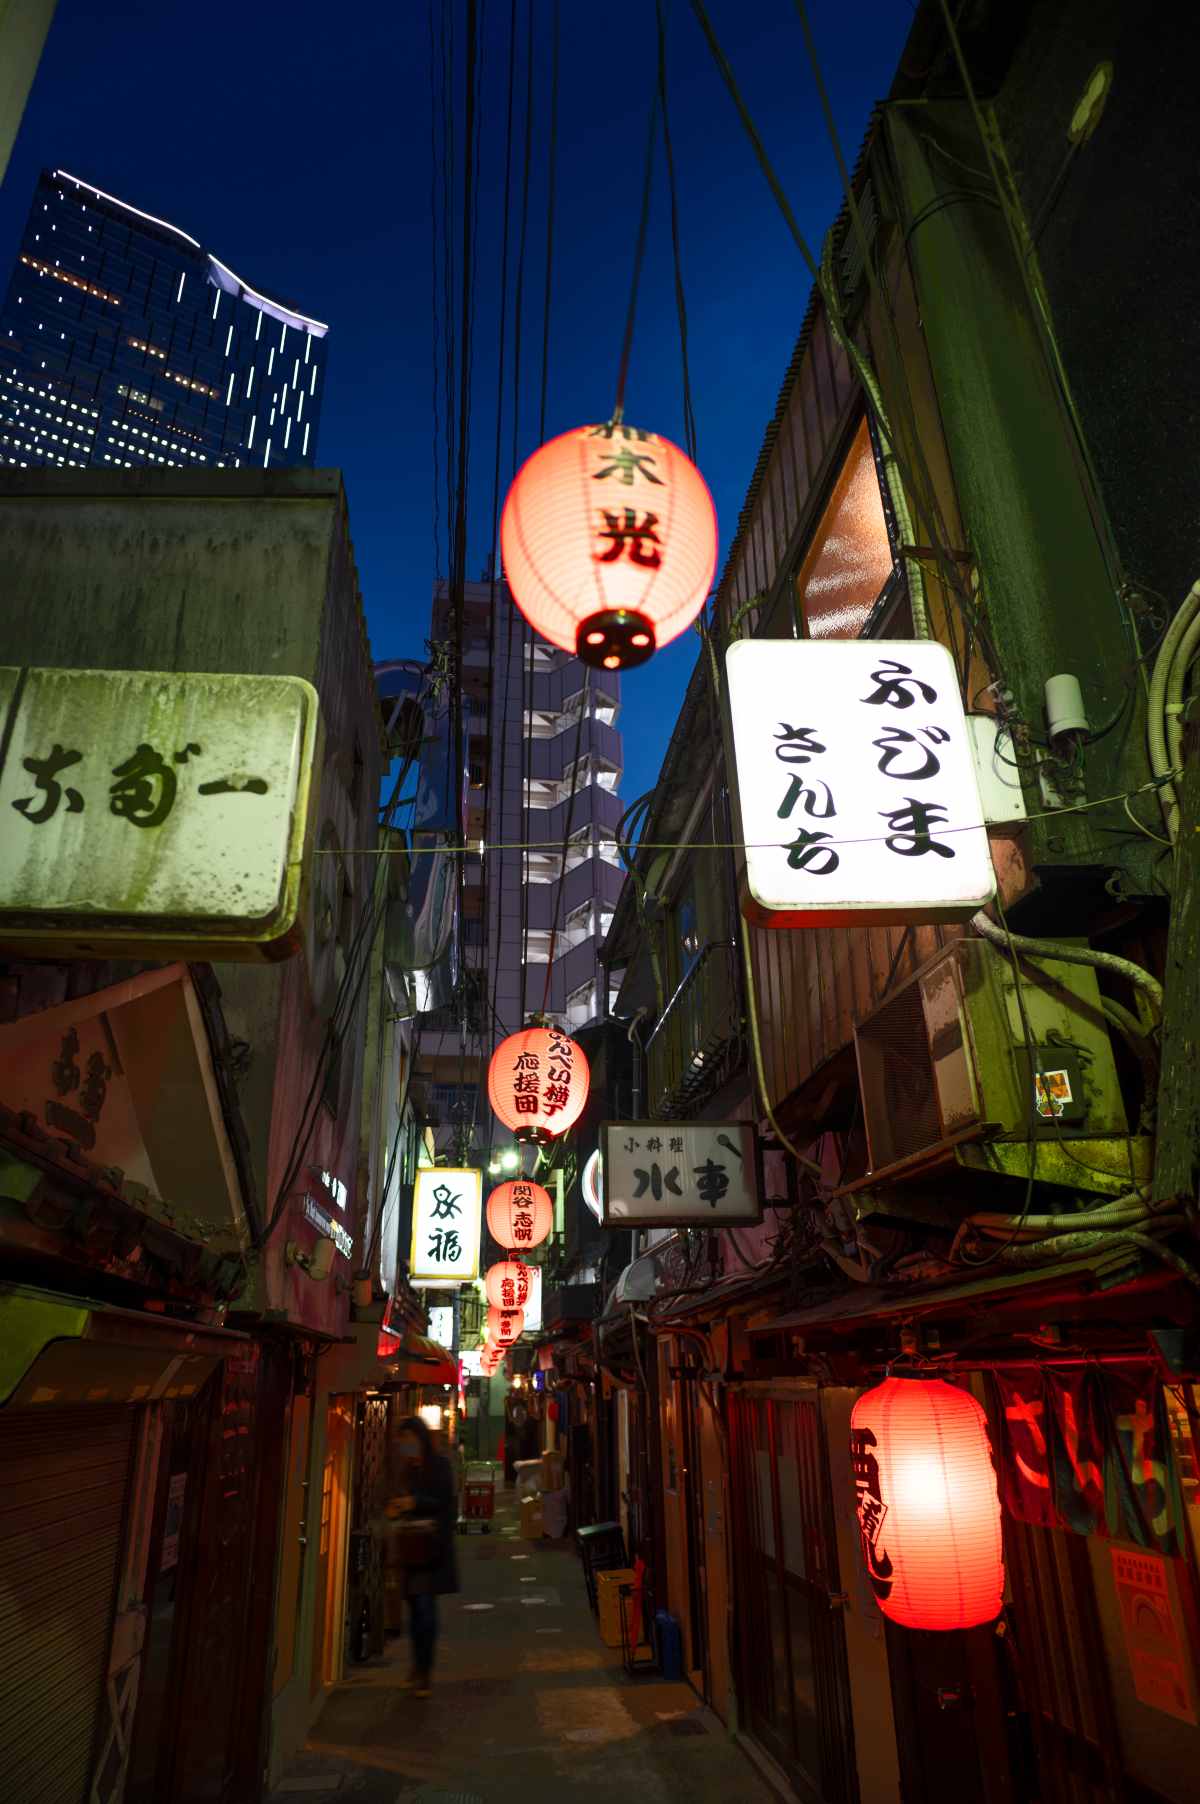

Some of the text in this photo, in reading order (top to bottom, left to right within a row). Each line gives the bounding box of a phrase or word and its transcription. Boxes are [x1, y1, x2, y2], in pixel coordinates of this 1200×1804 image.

[773, 722, 840, 875] さんち
[512, 1051, 541, 1114] 応援団
[624, 1136, 684, 1153] 小料理
[632, 1158, 730, 1208] 水車
